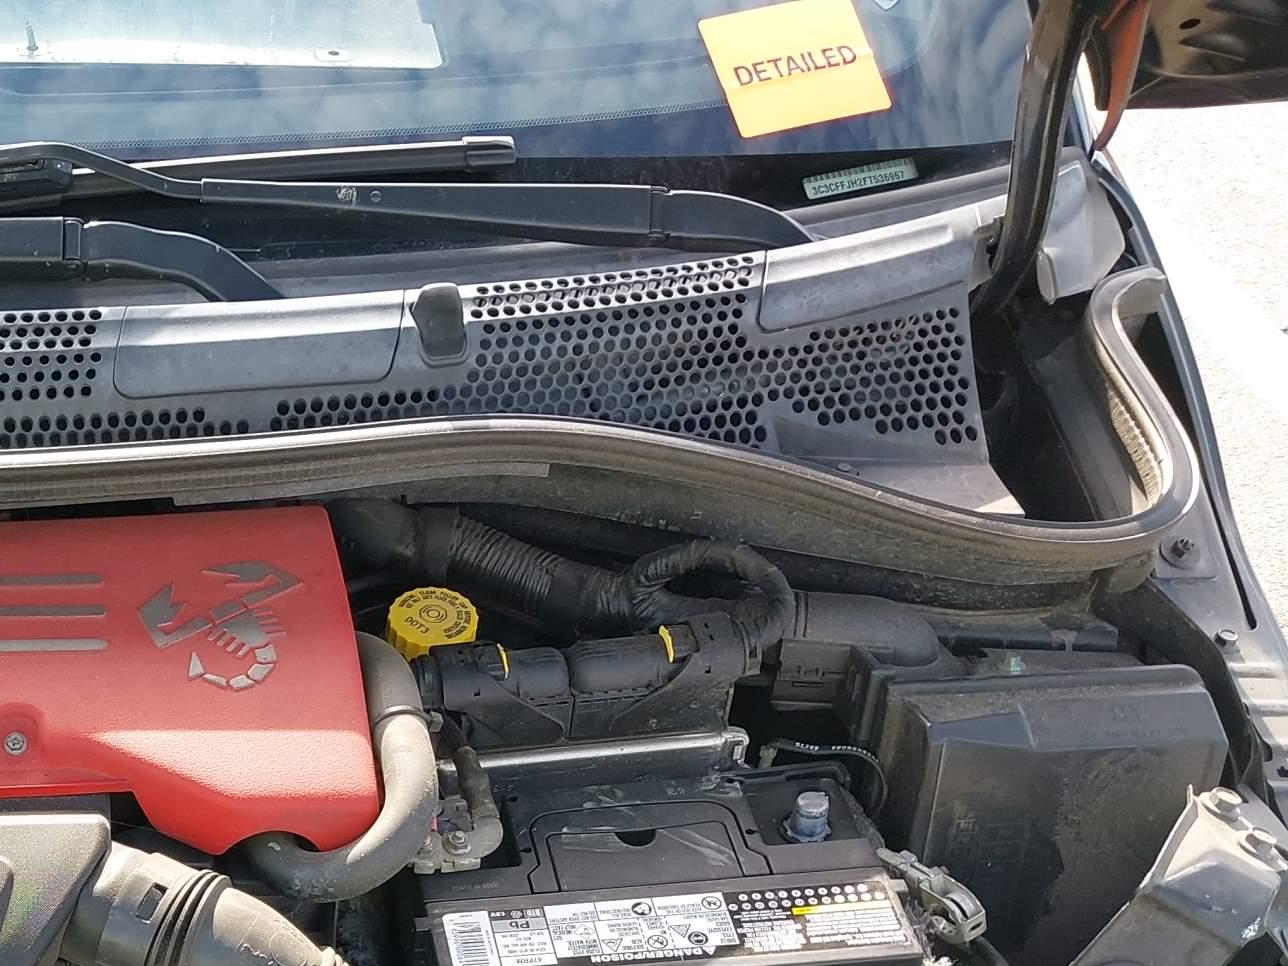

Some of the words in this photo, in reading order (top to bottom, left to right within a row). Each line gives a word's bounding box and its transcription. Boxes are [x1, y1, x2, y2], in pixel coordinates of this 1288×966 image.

[733, 45, 857, 86] DETAILED
[403, 616, 431, 634] DOT3
[509, 920, 530, 929] Pb
[590, 948, 703, 962] DANGER/POISON
